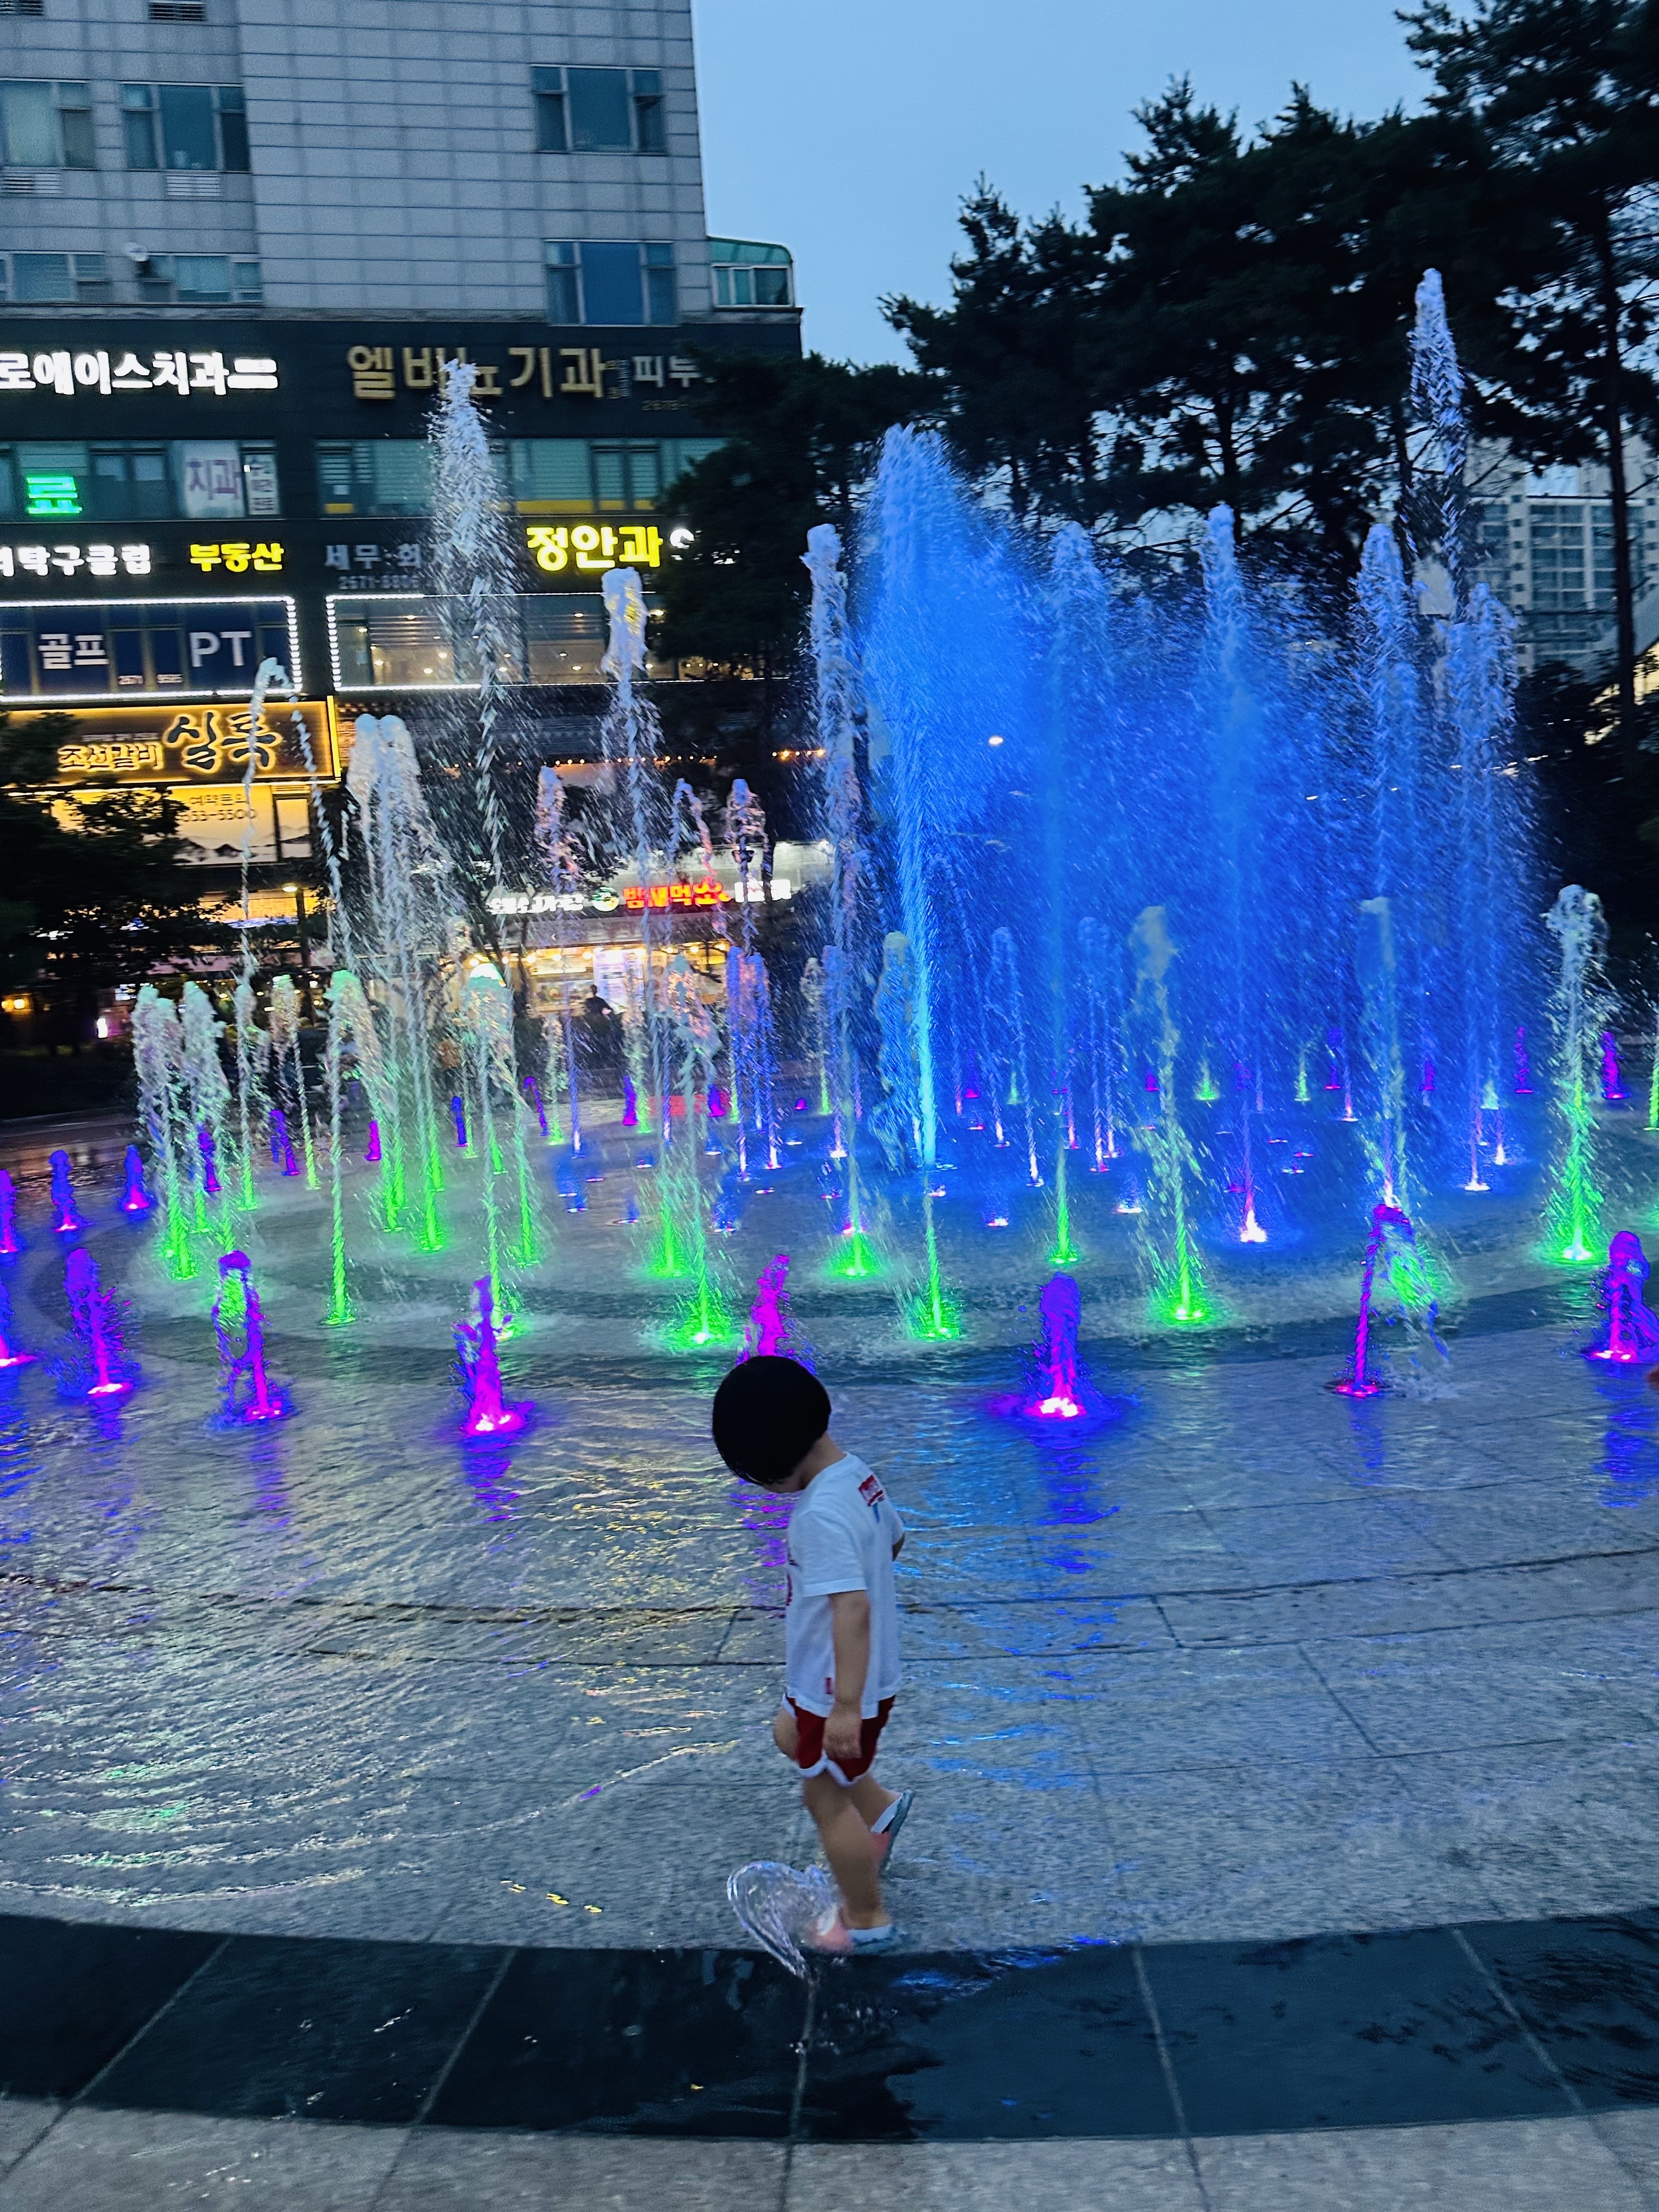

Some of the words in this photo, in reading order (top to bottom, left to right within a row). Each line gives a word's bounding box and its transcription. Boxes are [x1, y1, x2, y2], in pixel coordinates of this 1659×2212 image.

[632, 356, 715, 387] 피부
[187, 459, 241, 500] 치과
[190, 543, 284, 572] 부동산
[526, 525, 663, 571] 정안과
[38, 634, 109, 669] 골프
[189, 631, 252, 667] PT
[57, 742, 164, 772] 조선갈비
